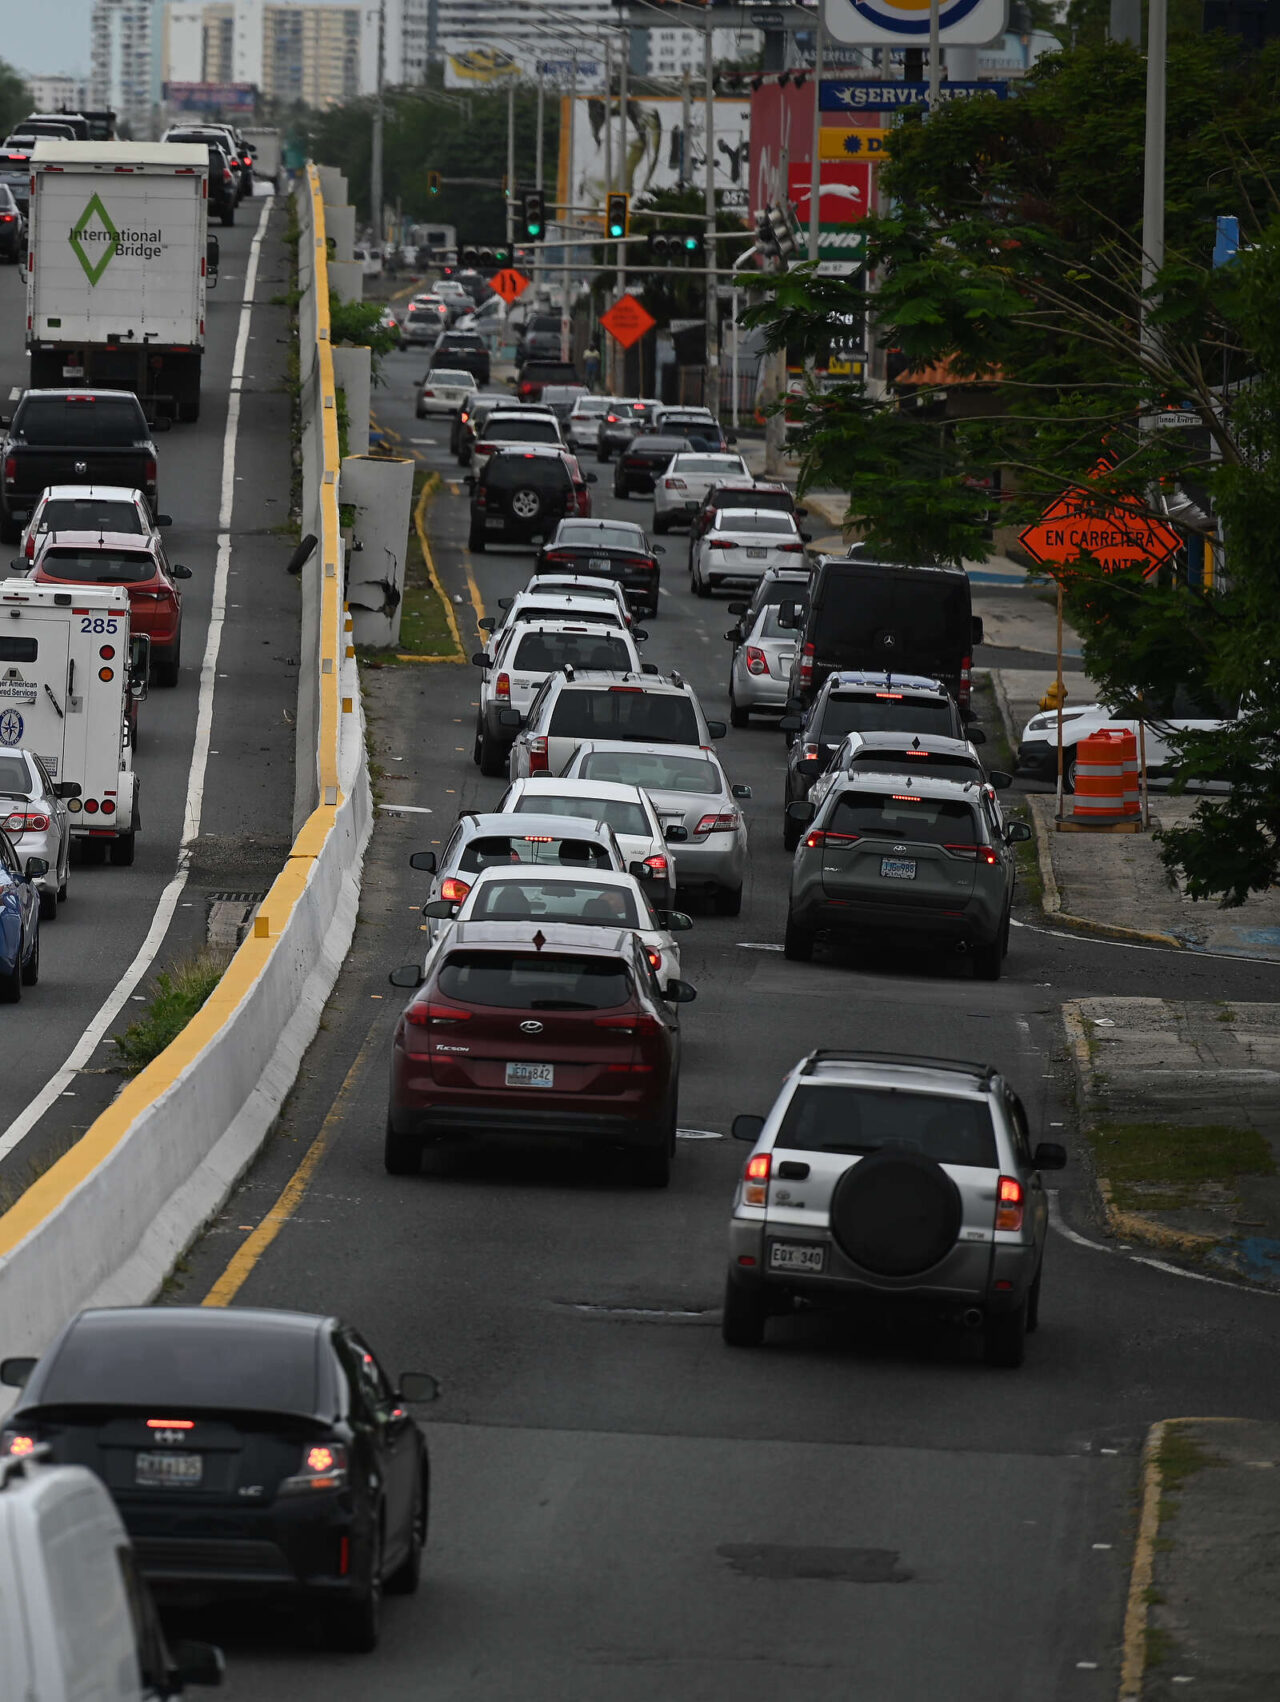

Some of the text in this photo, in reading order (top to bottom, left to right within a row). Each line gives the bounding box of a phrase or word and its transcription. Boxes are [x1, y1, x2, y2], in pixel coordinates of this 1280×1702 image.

[69, 228, 162, 243] International
[115, 243, 162, 260] Bridge
[1045, 530, 1155, 548] EN CARRETERA
[80, 618, 118, 635] 285
[9, 680, 38, 689] American
[12, 690, 37, 698] Services
